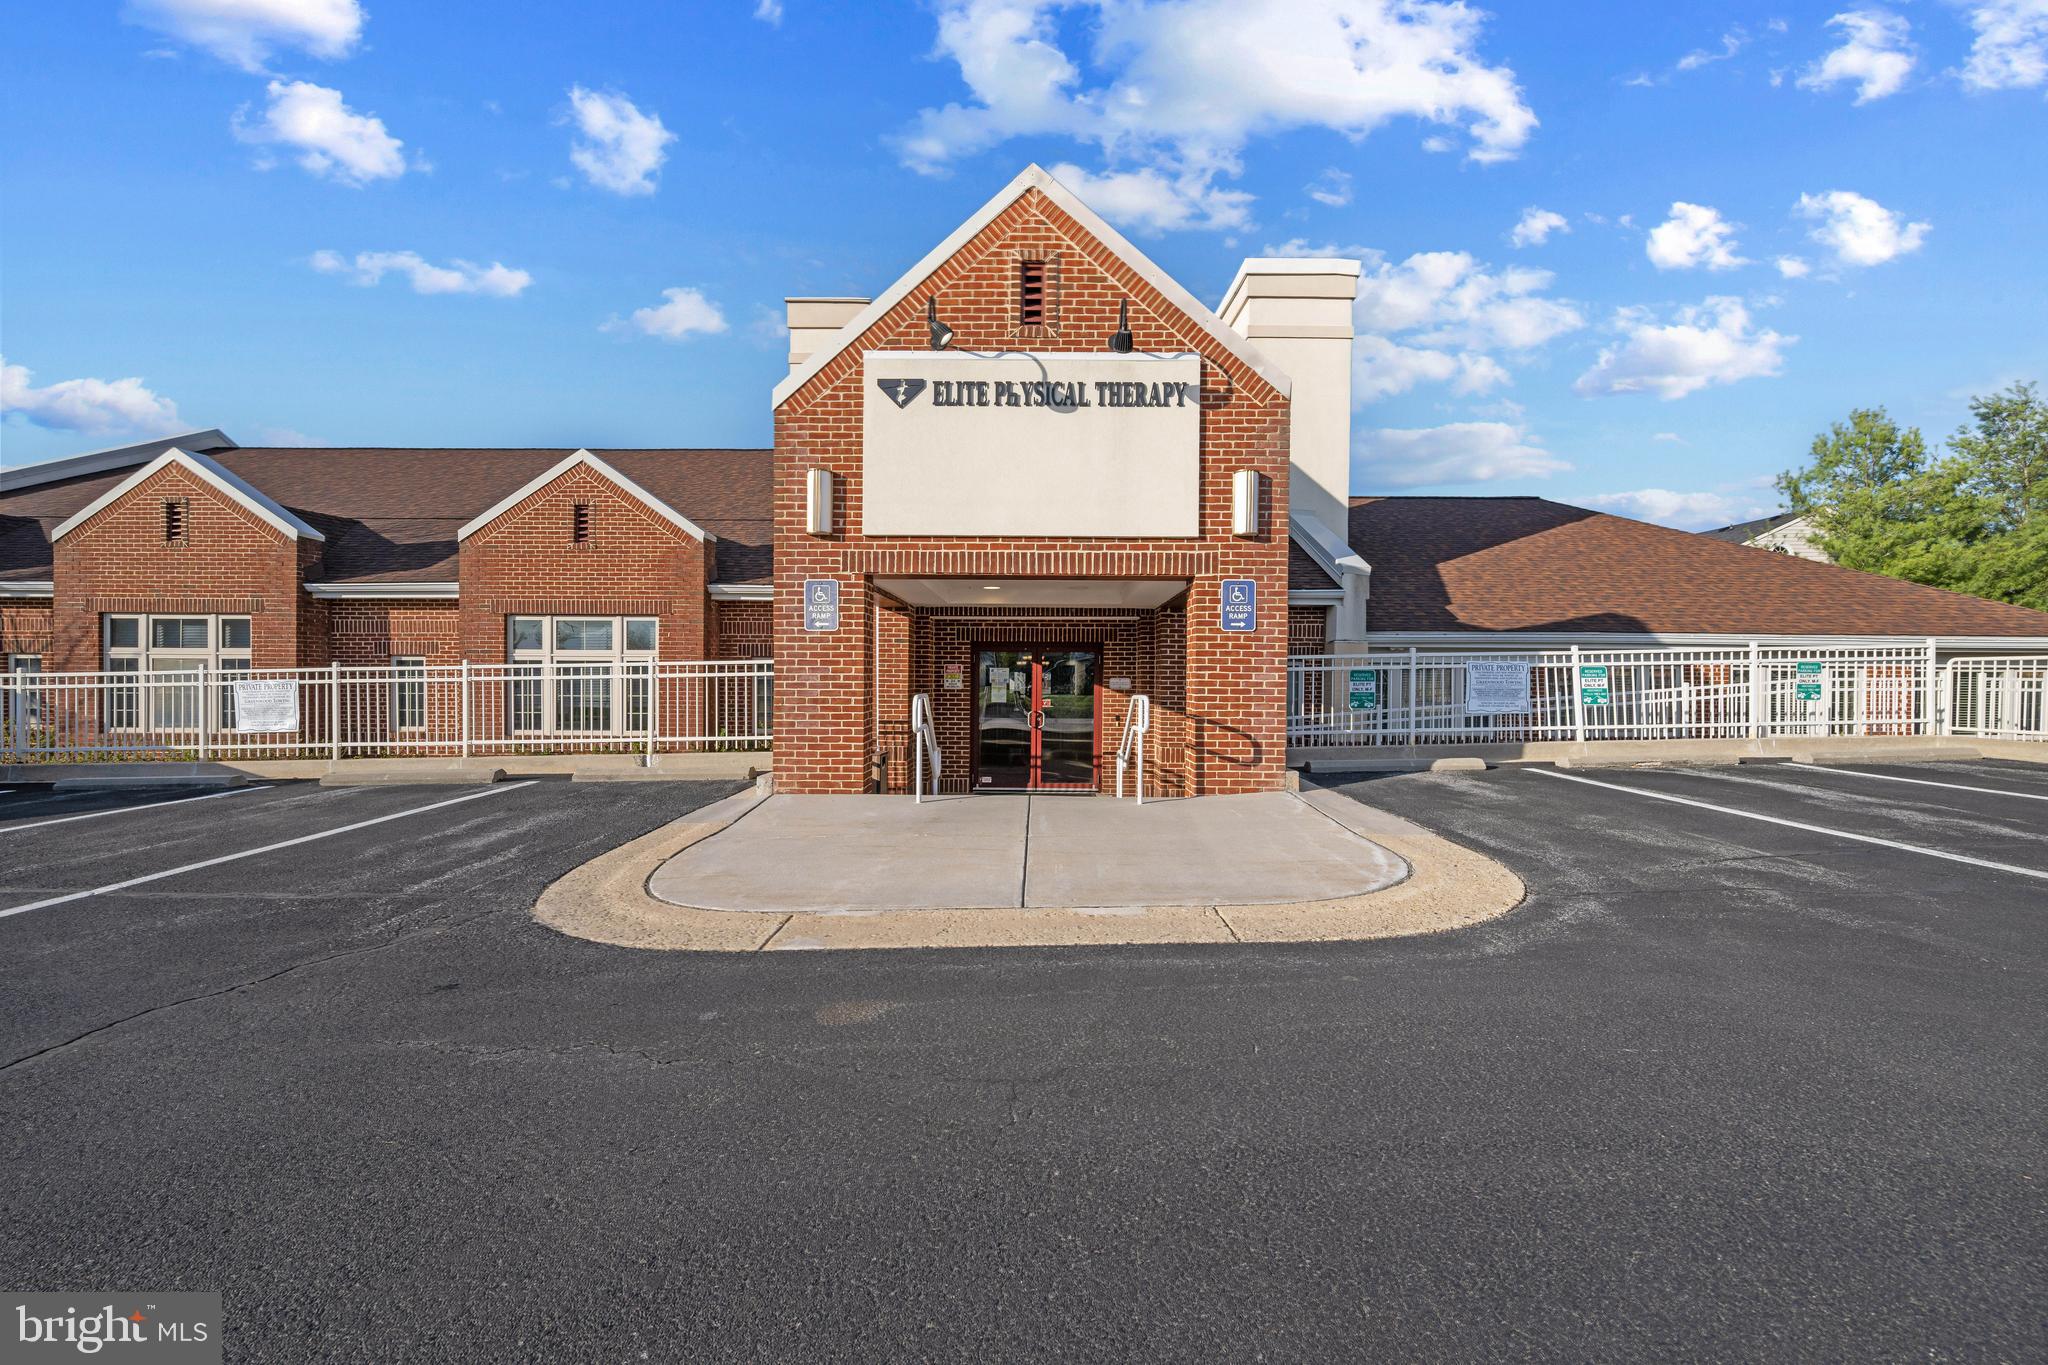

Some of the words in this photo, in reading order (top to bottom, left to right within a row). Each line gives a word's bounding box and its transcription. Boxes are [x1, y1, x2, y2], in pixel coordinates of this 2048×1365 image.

[932, 380, 990, 407] ELITE
[1095, 380, 1190, 408] THERAPY
[1496, 664, 1526, 672] PROPERTY
